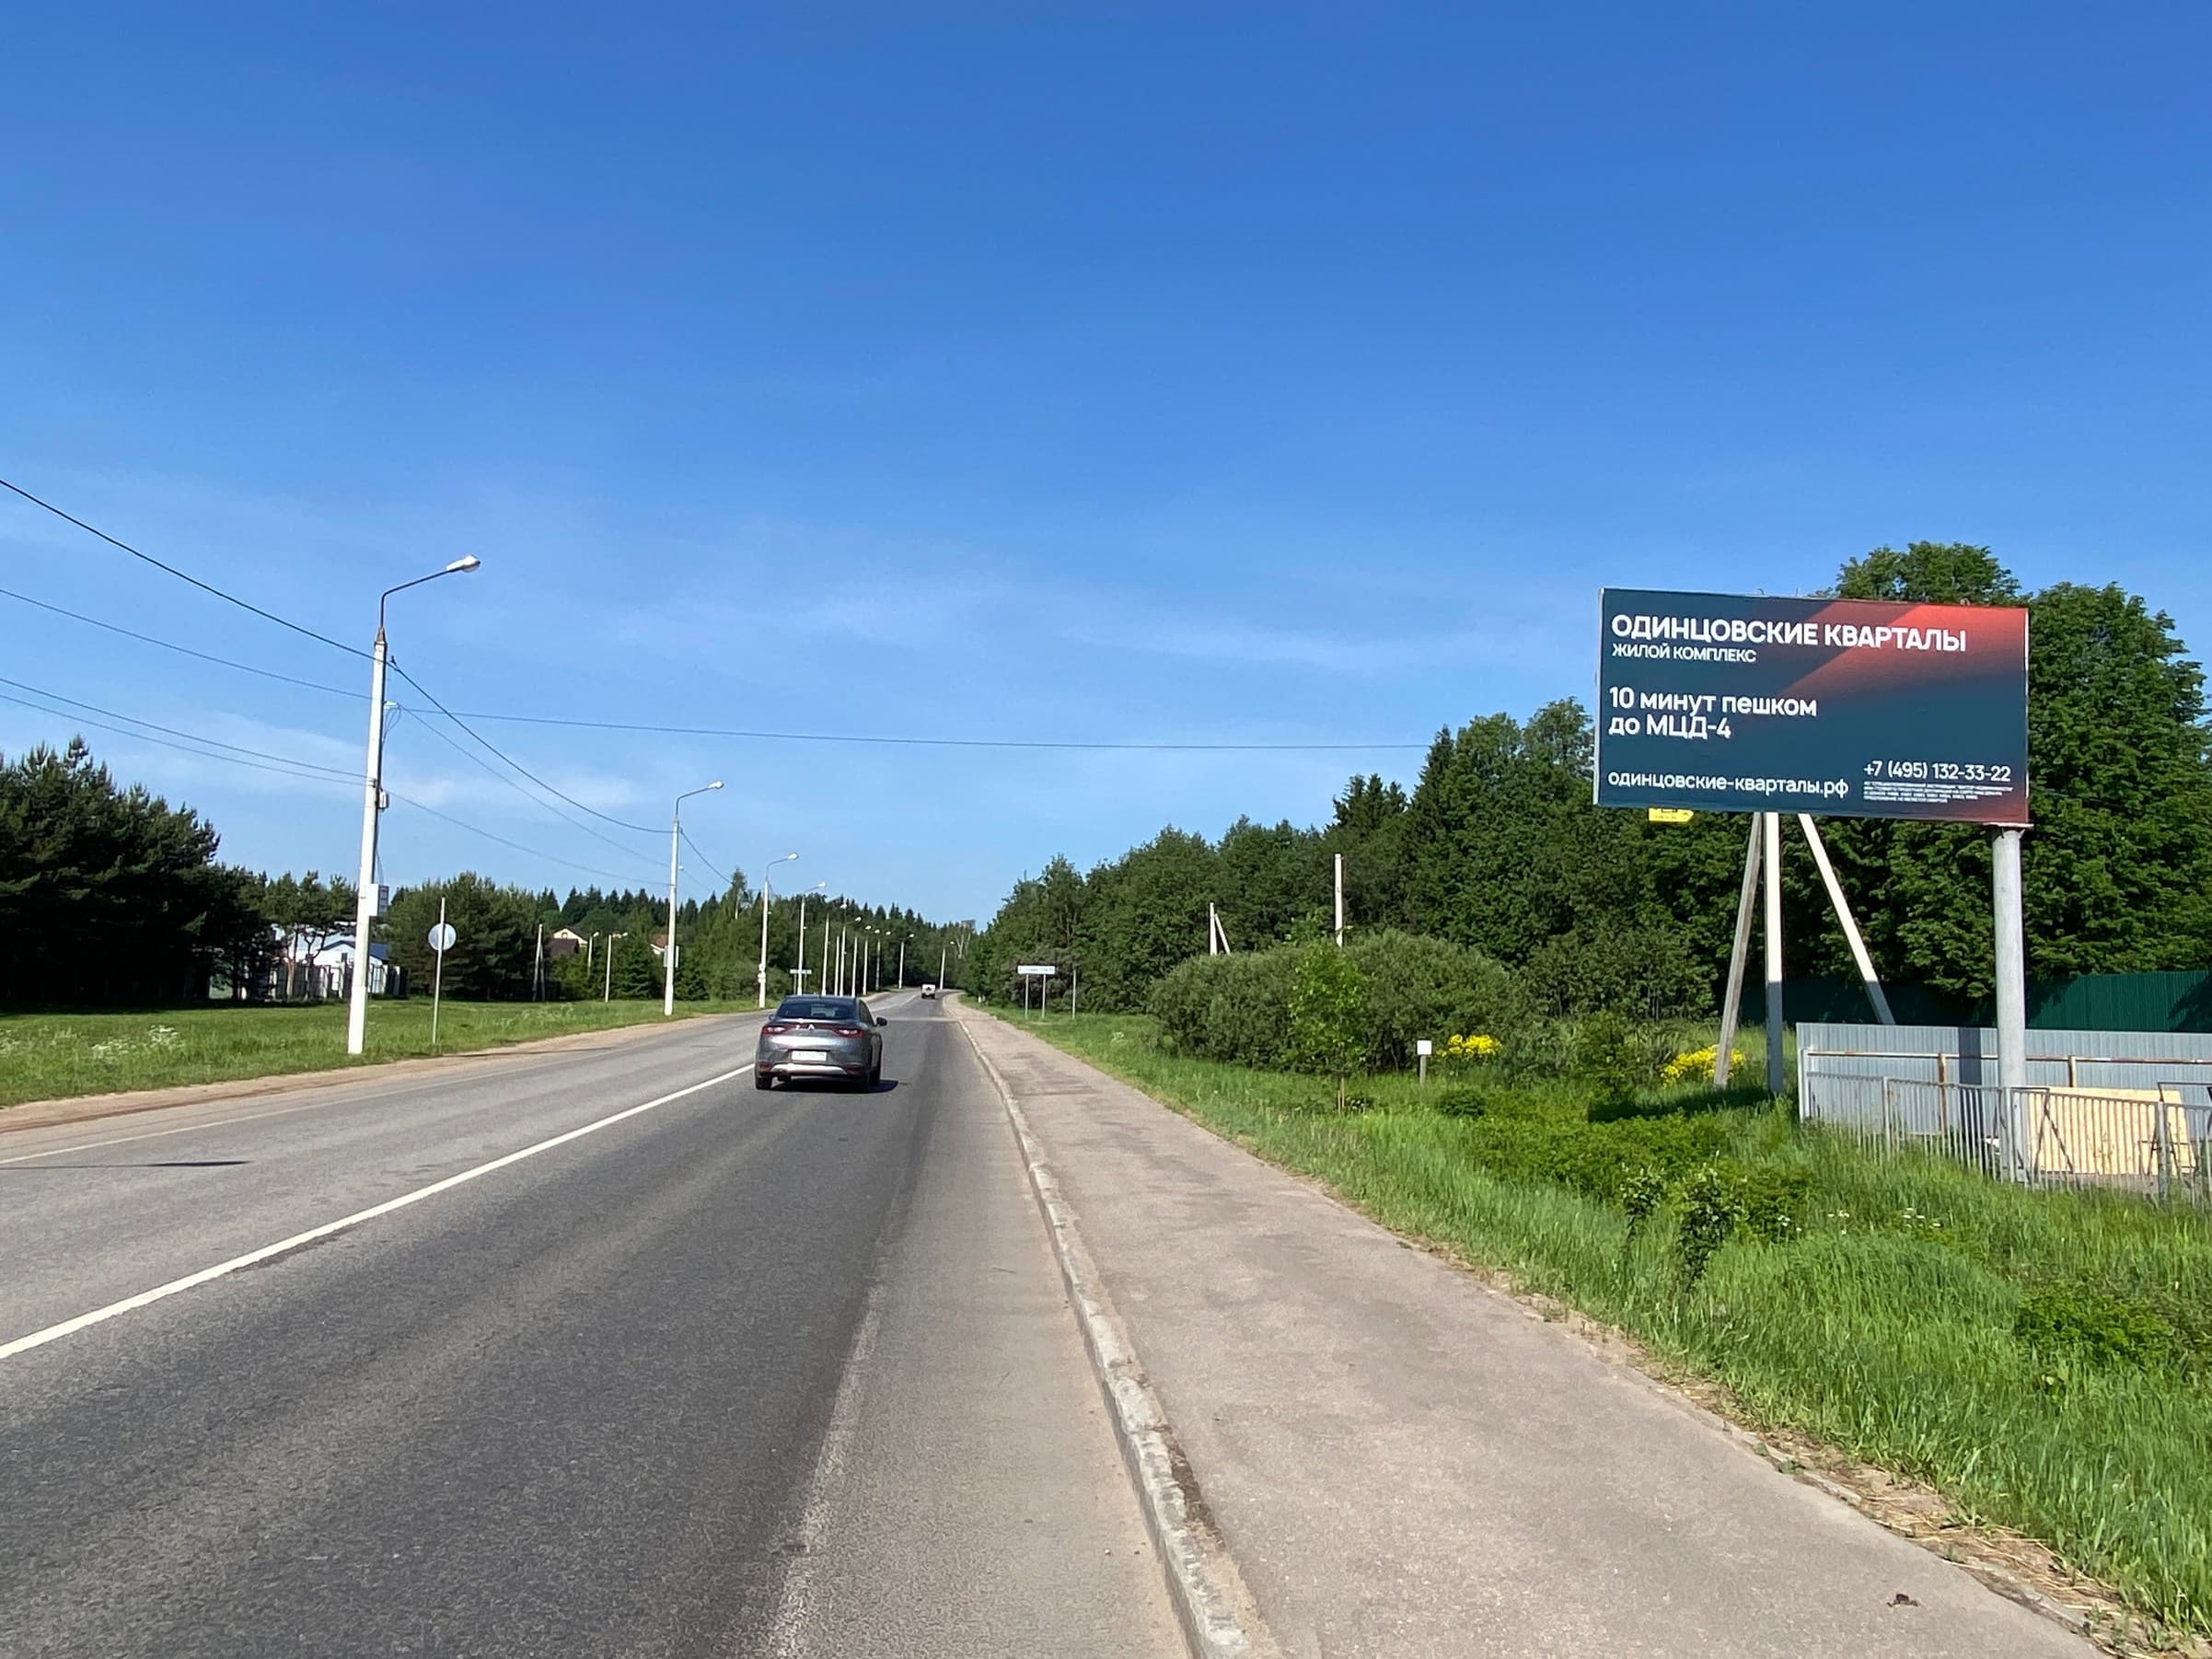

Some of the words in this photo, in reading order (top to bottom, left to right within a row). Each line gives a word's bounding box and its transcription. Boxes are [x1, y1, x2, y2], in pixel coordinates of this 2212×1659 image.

[1611, 614, 1818, 645] ОДИНЦОВСКИЕ
[1824, 624, 1966, 651] КВАРТАЛЫ
[1612, 643, 1669, 658] ЖИЛОЙ
[1673, 647, 1757, 662] КОМПЛЕКС
[1609, 687, 1635, 709] 10
[1639, 692, 1717, 716] минут
[1721, 696, 1817, 716] пешком
[1608, 717, 1640, 736] до
[1646, 714, 1731, 739] МЦД-4
[1863, 760, 1883, 777] +7
[1887, 760, 1928, 779] (495)
[1932, 763, 2011, 782] 132-33-22
[1608, 772, 1849, 798] одинцовские-кварталы.рф
